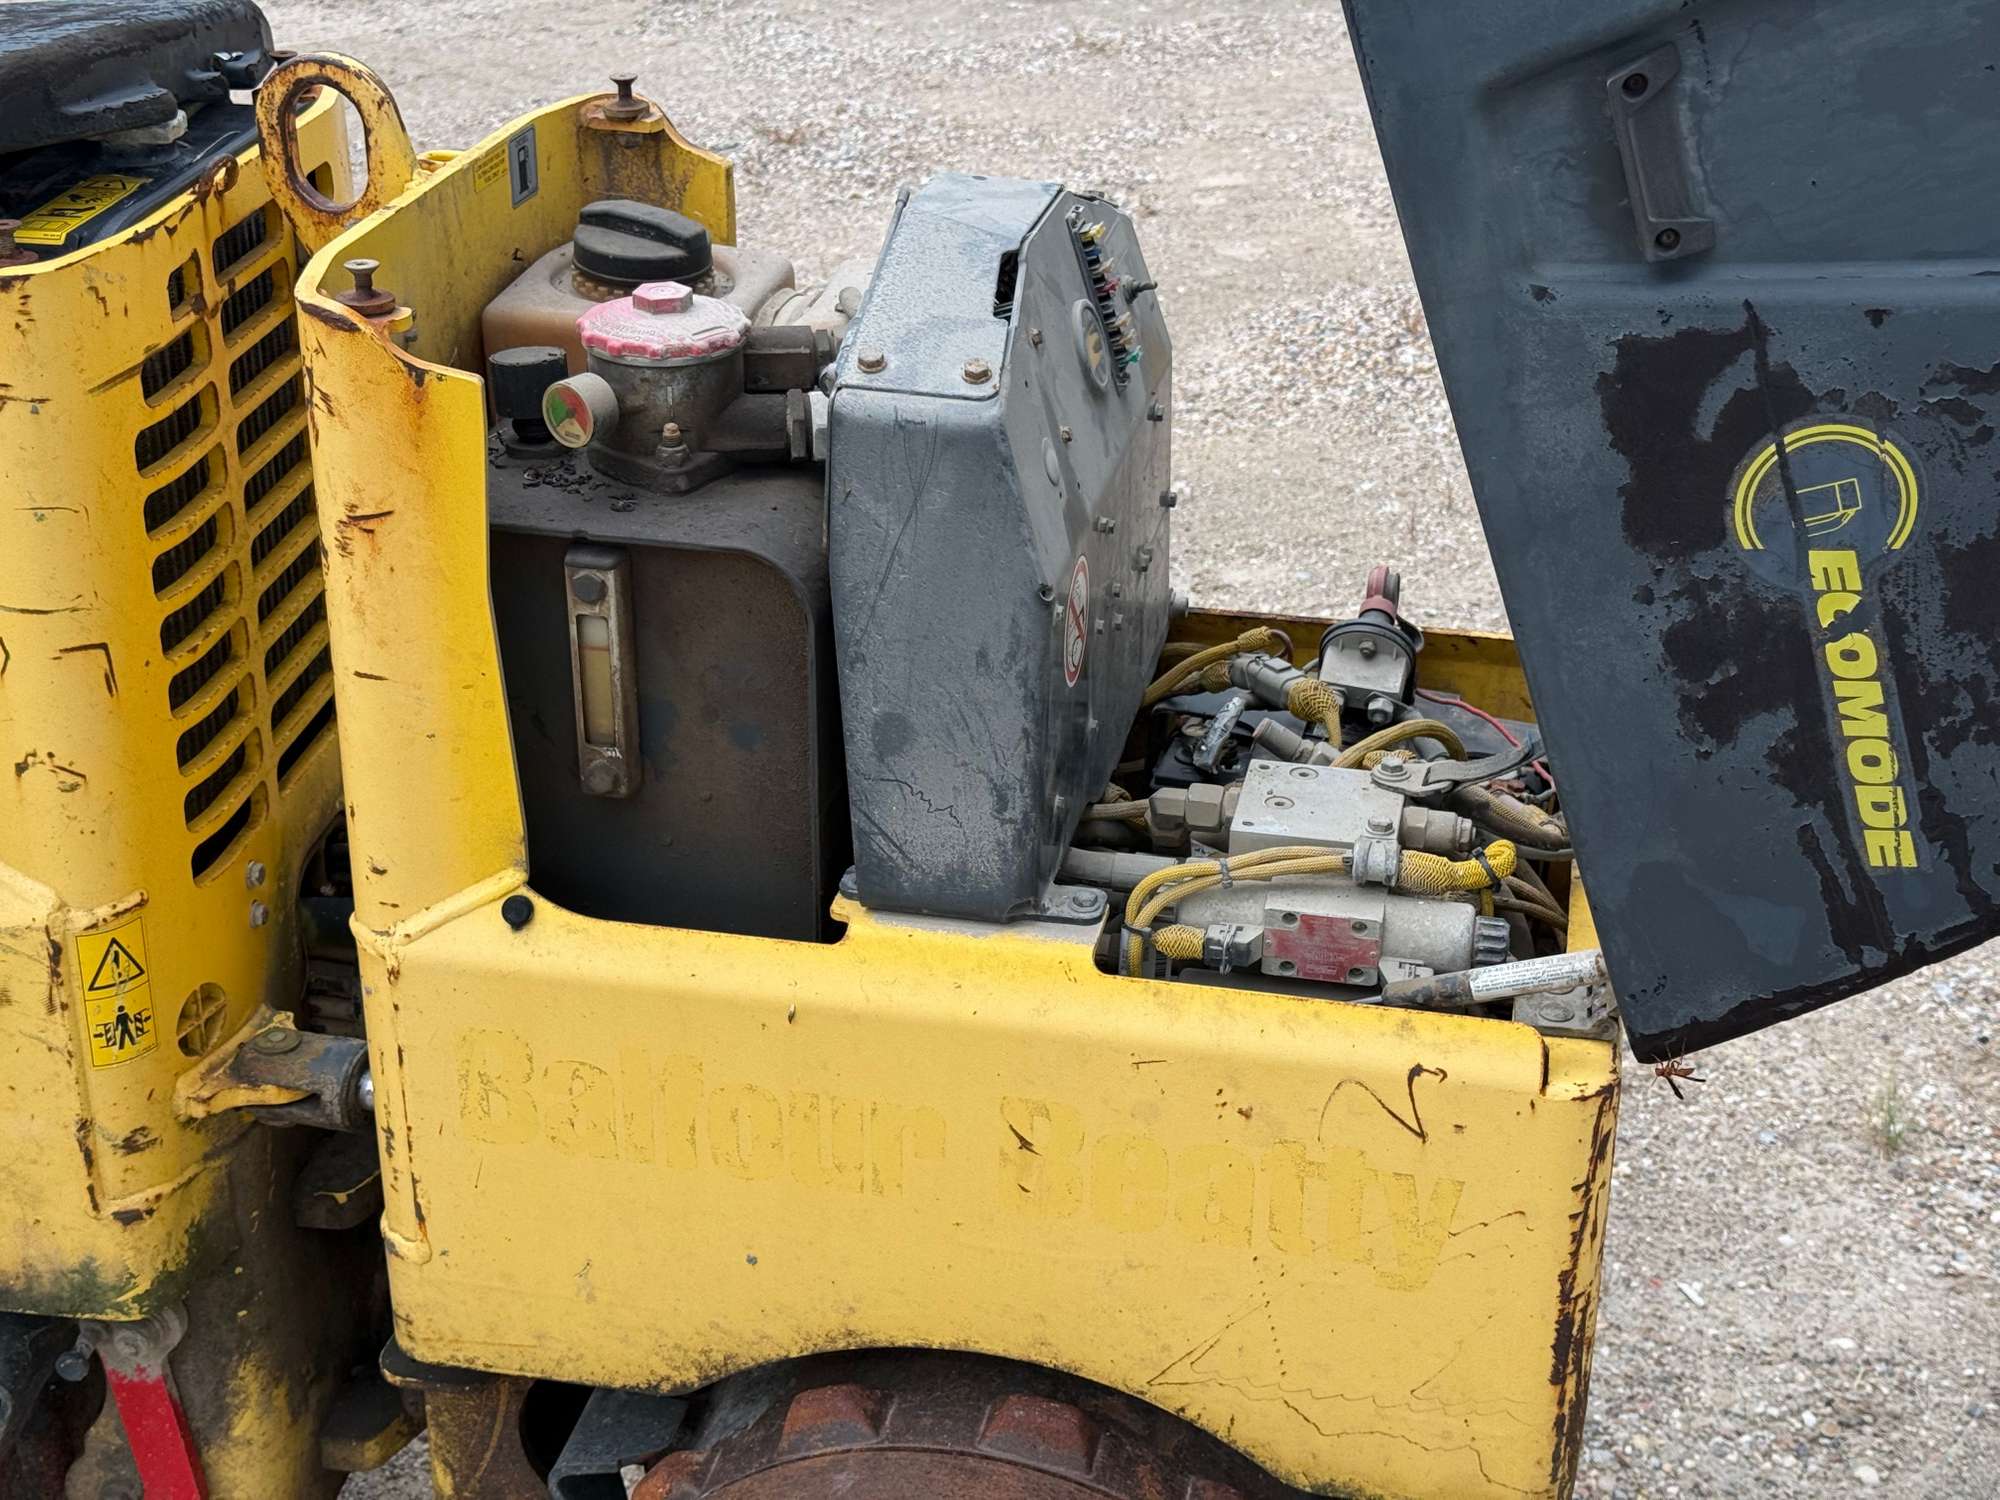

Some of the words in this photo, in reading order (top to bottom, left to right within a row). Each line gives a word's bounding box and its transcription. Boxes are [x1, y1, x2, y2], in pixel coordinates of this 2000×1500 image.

[1808, 550, 1918, 868] ECOMODE
[458, 1028, 945, 1198] Balfour
[1000, 1095, 1466, 1293] Beatty
